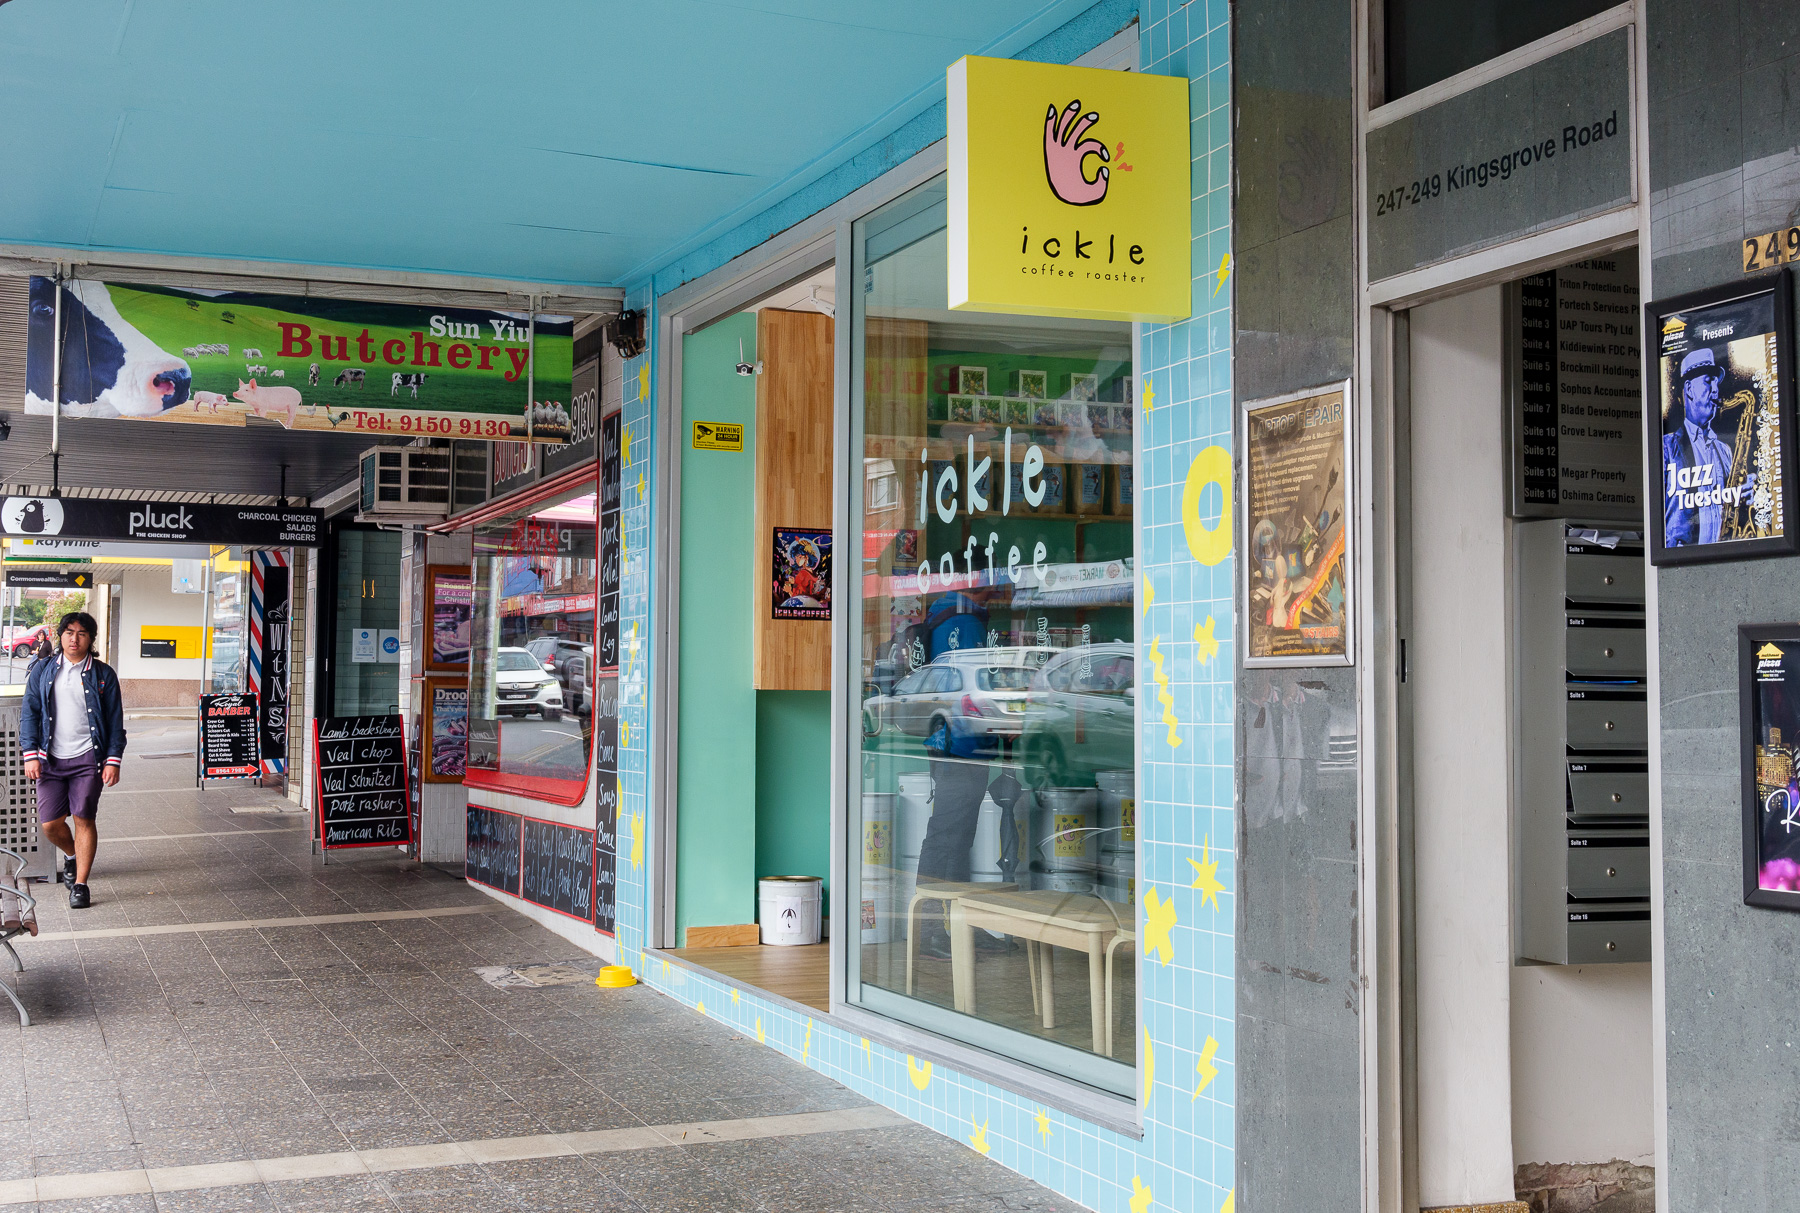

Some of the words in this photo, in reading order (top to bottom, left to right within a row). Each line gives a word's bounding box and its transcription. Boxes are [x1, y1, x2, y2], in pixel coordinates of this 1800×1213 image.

[1376, 174, 1441, 217] 247-249
[1448, 138, 1556, 192] Kingsgrove
[1562, 110, 1617, 153] Road
[1022, 226, 1145, 265] ickle
[1745, 228, 1800, 271] 249
[1022, 264, 1074, 278] coffee
[1086, 272, 1145, 283] roaster
[1592, 260, 1617, 272] NAME
[1560, 279, 1580, 290] Triton
[1582, 281, 1622, 293] Protection
[1624, 284, 1640, 295] Grou
[1522, 296, 1542, 307] Suite
[1544, 298, 1550, 308] 2
[1560, 299, 1590, 311] Fortech
[1593, 302, 1629, 314] Services
[1632, 304, 1640, 315] Pt
[429, 315, 480, 340] Sun
[489, 319, 530, 342] Yiu
[1522, 318, 1542, 328] Suite
[1544, 320, 1550, 329] 3
[1560, 320, 1578, 331] UAP
[1580, 321, 1603, 333] Tours
[1605, 323, 1618, 336] Pty
[1620, 325, 1633, 336] Ltd
[1702, 325, 1734, 341] Presents
[276, 322, 530, 382] Butchery
[1523, 338, 1542, 349] Suite
[1544, 340, 1550, 350] 4
[1560, 340, 1606, 354] Kiddiewink
[1608, 344, 1626, 356] FDC
[1628, 347, 1640, 359] Pty
[1768, 336, 1778, 374] month
[1523, 360, 1543, 370] Suite
[1545, 362, 1550, 371] 5
[1560, 362, 1600, 374] Brockmill
[1602, 364, 1640, 379] Holdings
[1524, 381, 1543, 391] Suite
[1546, 382, 1551, 392] 6
[1560, 383, 1592, 396] Sophos
[1770, 379, 1780, 408] each
[1524, 402, 1544, 412] Suite
[1546, 404, 1551, 413] 7
[1561, 404, 1584, 416] Blade
[1588, 406, 1642, 420] Development
[353, 411, 392, 430] Tel:
[400, 415, 452, 434] 9150
[460, 418, 511, 437] 9130
[716, 426, 740, 434] WARNING
[1524, 426, 1544, 436] Suite
[1546, 427, 1556, 437] 10
[1561, 425, 1586, 437] Grove
[1588, 427, 1622, 440] Lawyers
[1524, 445, 1544, 455] Suite
[1546, 446, 1556, 456] 12
[1772, 430, 1782, 482] Tuesday
[920, 426, 1046, 524] ickle
[1524, 466, 1544, 476] Suite
[1546, 468, 1556, 478] 13
[1562, 468, 1588, 480] Megar
[1591, 469, 1626, 482] Property
[1667, 463, 1714, 498] Jazz
[1524, 488, 1544, 498] Suite
[1547, 489, 1556, 499] 16
[1562, 490, 1594, 502] Oshima
[1596, 492, 1636, 504] Ceramics
[1676, 484, 1742, 510] Tuesday
[1774, 486, 1784, 530] Second
[130, 504, 194, 535] pluck
[238, 512, 280, 522] CHARCOAL
[282, 514, 317, 523] CHICKEN
[286, 524, 316, 532] SALADS
[280, 532, 316, 542] BURGERS
[918, 532, 1048, 594] coffee
[801, 609, 830, 618] COFFEE
[1757, 658, 1782, 670] pizza
[208, 706, 251, 716] BARBER
[320, 719, 349, 739] Lamb
[327, 740, 354, 763] Veal
[361, 740, 392, 764] chop
[324, 768, 348, 792] Veal
[360, 793, 403, 812] rashers
[326, 826, 374, 842] American
